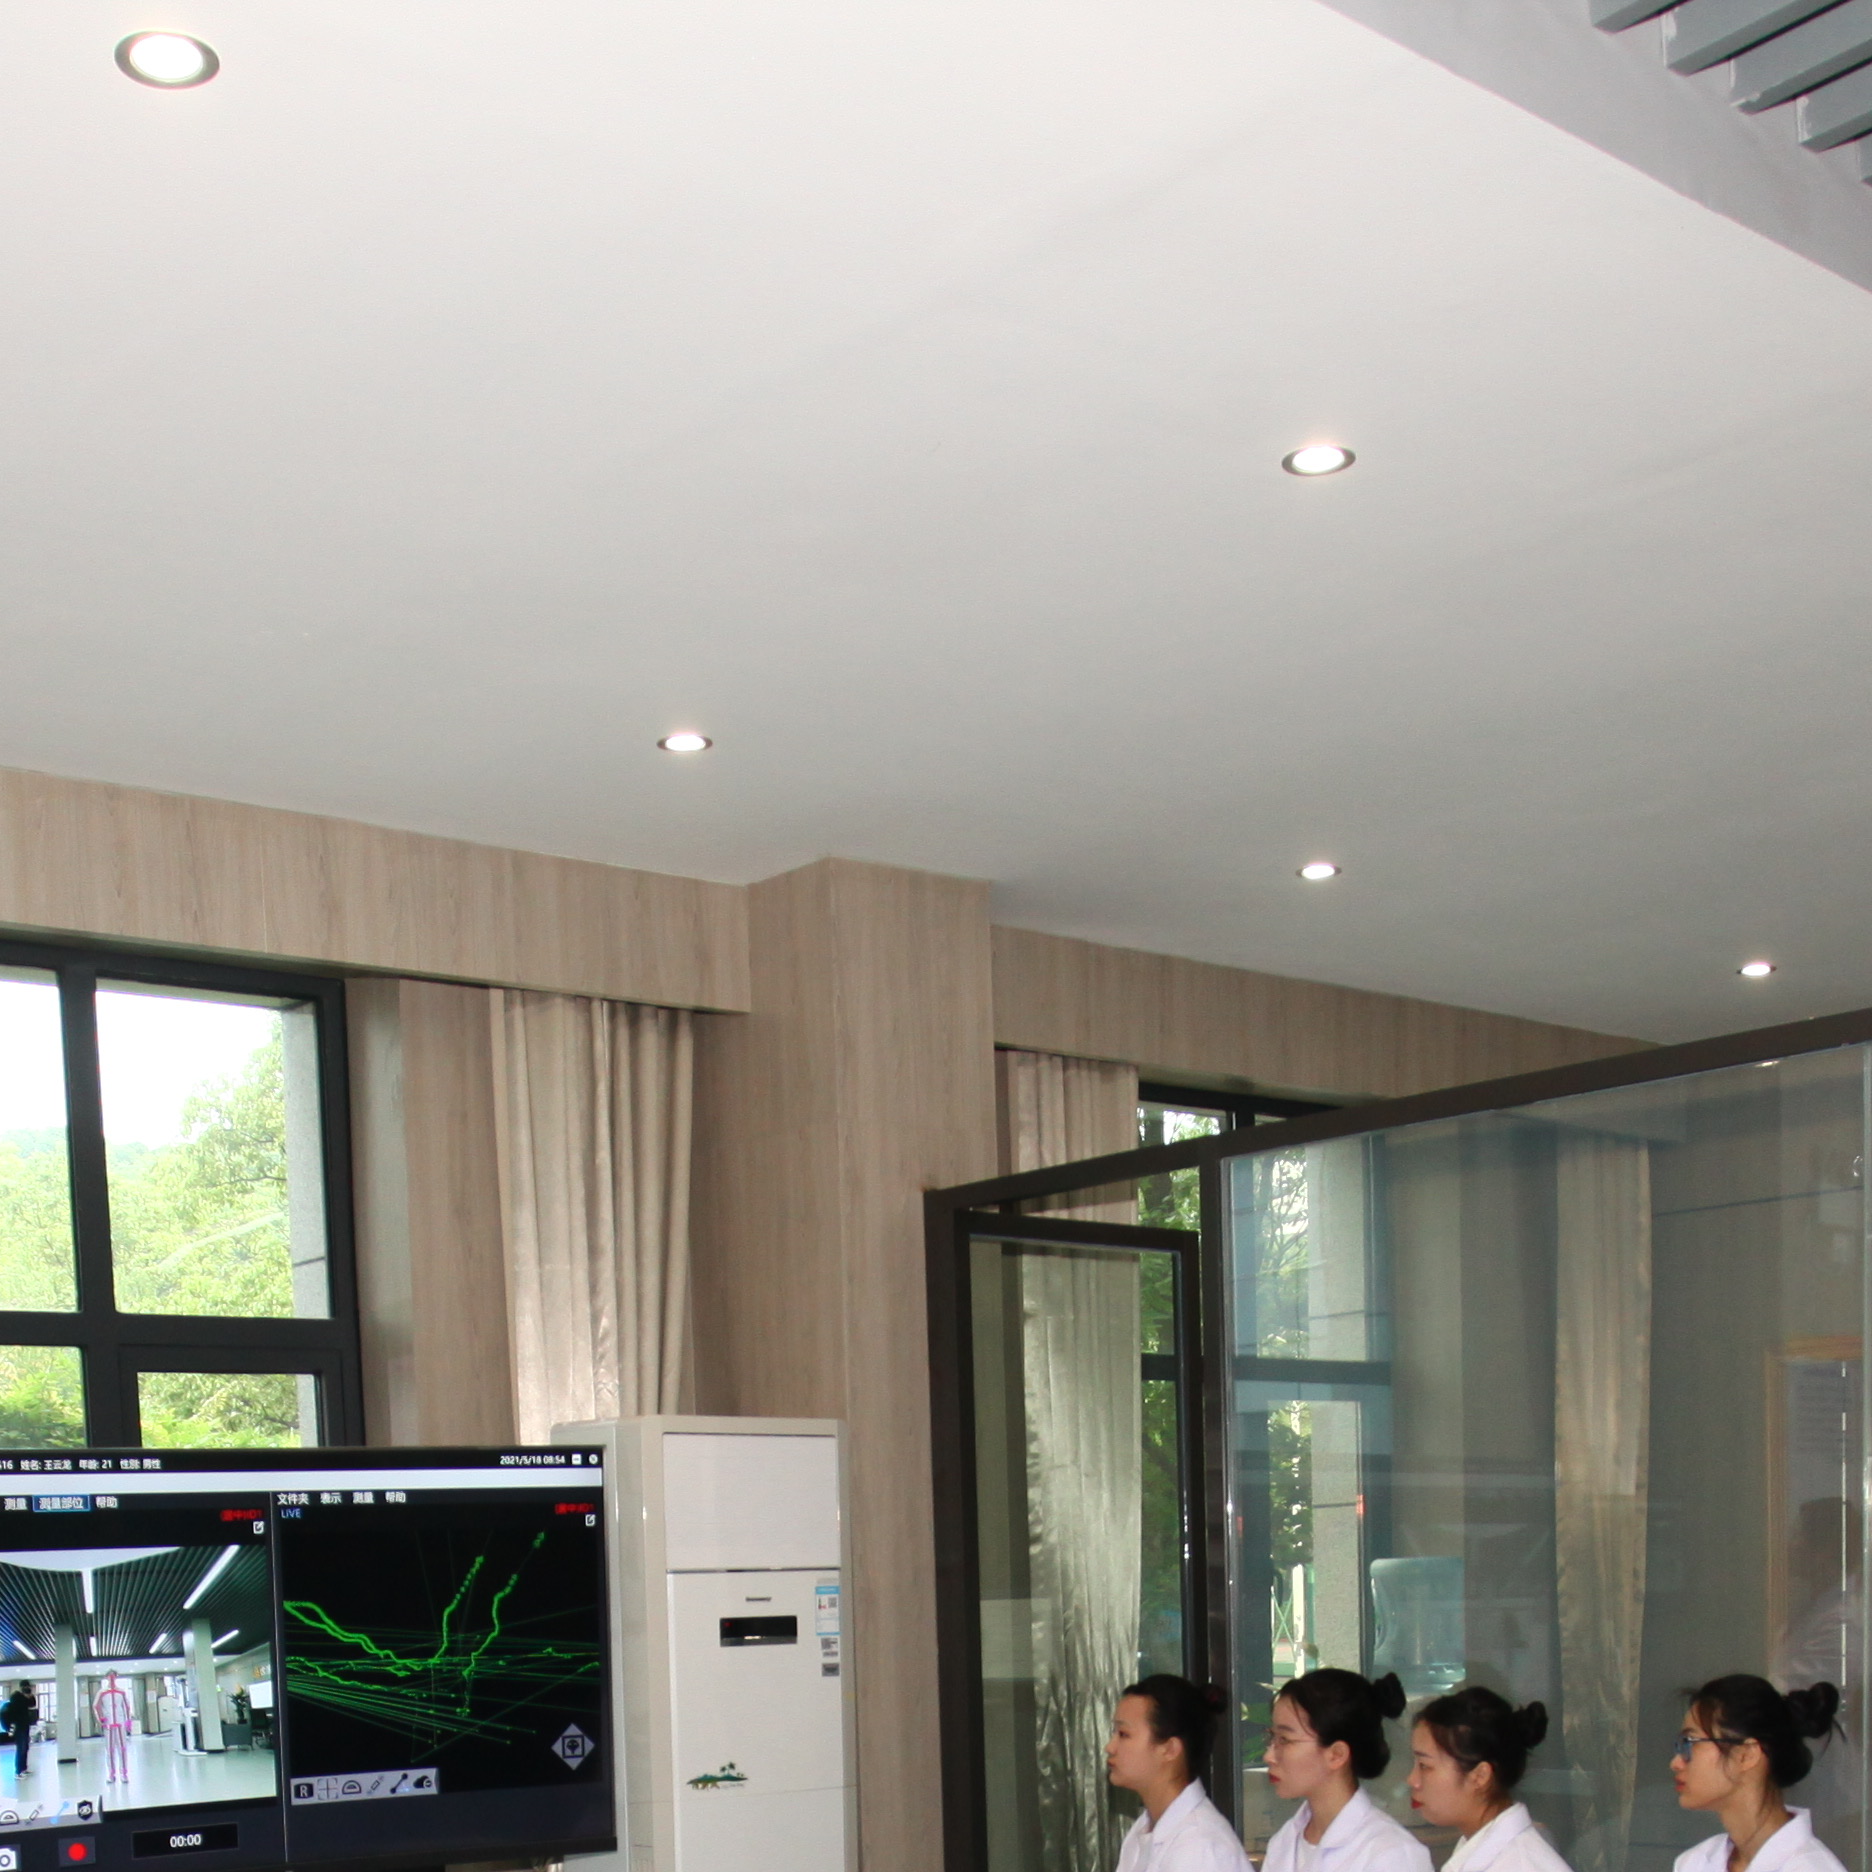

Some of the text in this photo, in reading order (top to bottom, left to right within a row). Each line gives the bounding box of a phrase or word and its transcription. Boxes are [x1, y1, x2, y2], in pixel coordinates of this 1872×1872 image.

[102, 1459, 112, 1469] 21
[142, 1459, 161, 1470] 男性
[4, 1498, 28, 1511] 测量
[39, 1497, 84, 1511] 测量部位
[95, 1496, 118, 1509] 帮助
[277, 1490, 407, 1506] 文件夹 表示 测量 帮助
[281, 1508, 302, 1519] LIVE
[169, 1833, 202, 1848] 00:00
